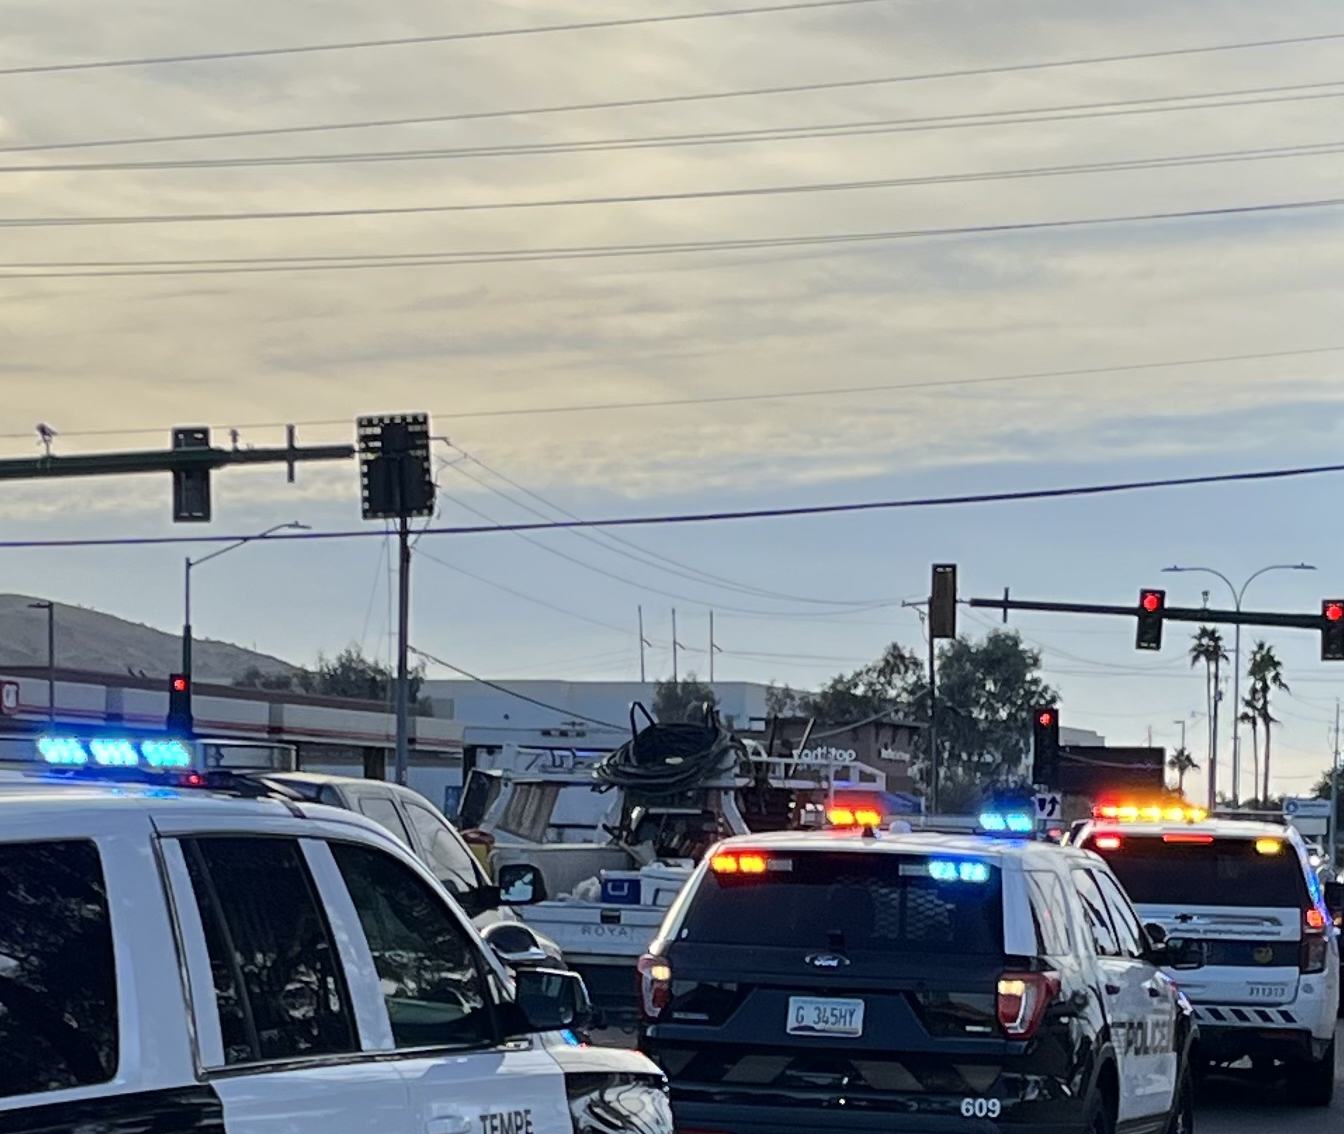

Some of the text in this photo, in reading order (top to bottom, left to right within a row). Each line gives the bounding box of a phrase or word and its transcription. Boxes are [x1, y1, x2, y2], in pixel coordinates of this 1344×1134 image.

[581, 926, 635, 937] ROYA
[796, 1005, 805, 1024] G
[960, 1098, 1002, 1118] 609
